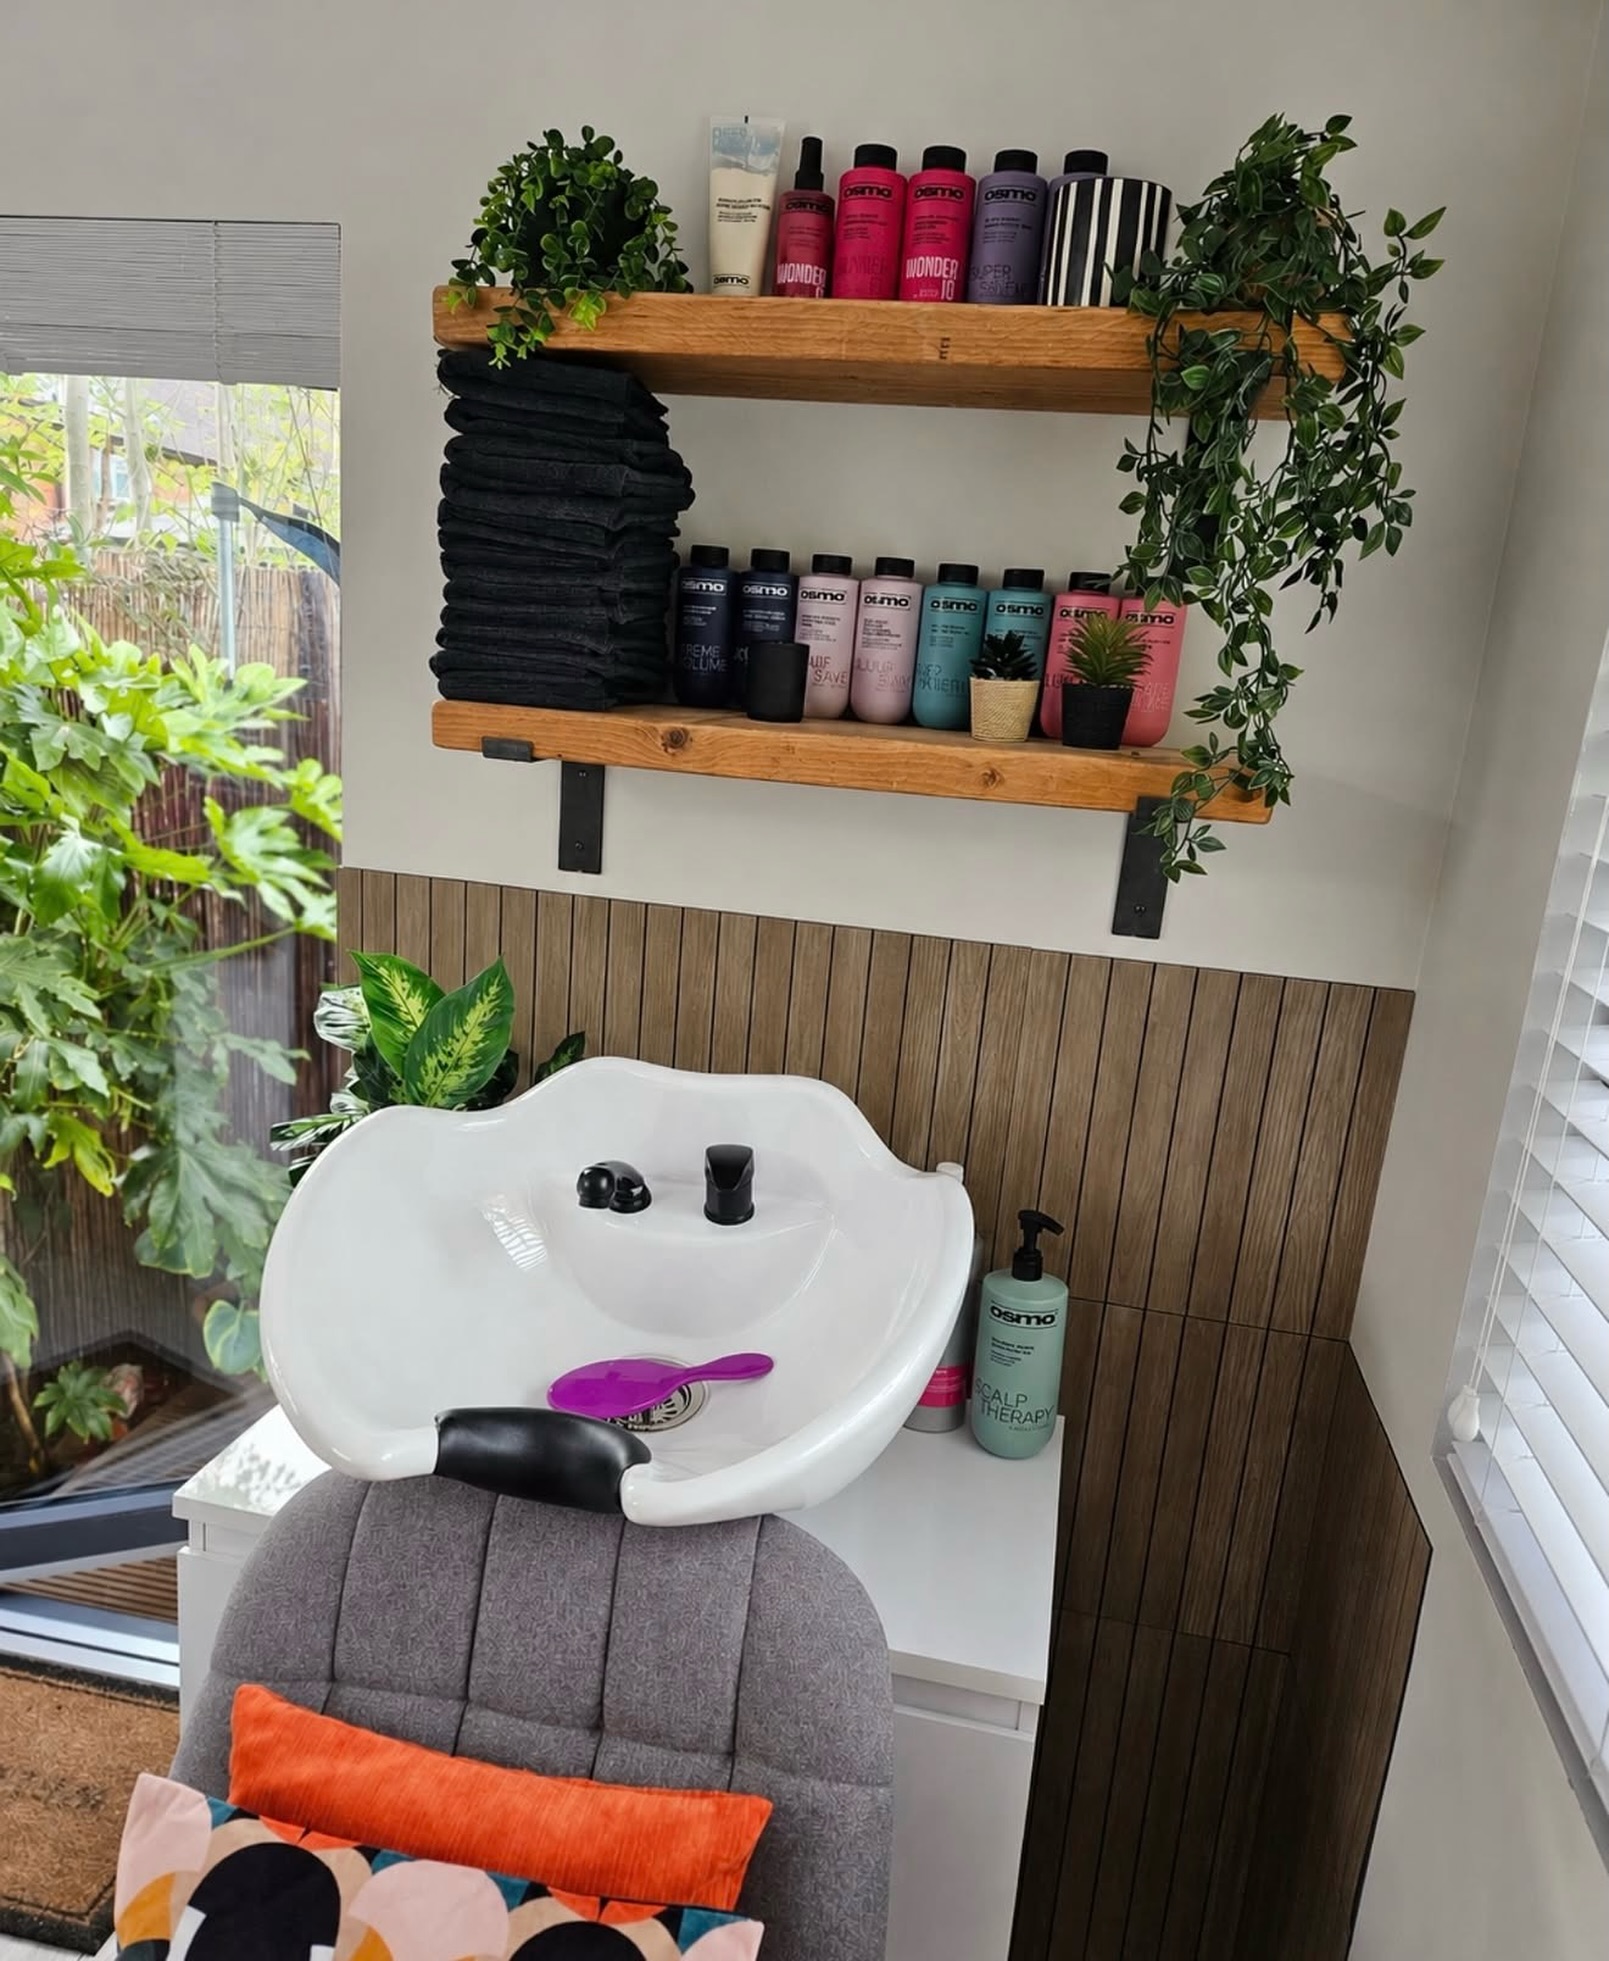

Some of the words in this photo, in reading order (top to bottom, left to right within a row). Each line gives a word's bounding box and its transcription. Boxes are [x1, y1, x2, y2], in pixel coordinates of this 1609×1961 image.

[844, 185, 892, 198] osmo
[914, 186, 964, 199] osmo
[984, 189, 1036, 202] osmo
[906, 256, 958, 280] WONDER
[713, 276, 750, 285] osmo
[777, 263, 827, 287] WONDER
[941, 280, 955, 300] 10
[682, 580, 724, 592] osmo
[743, 585, 788, 597] osmo
[800, 589, 845, 602] osmo
[864, 595, 909, 608] osmo
[930, 599, 978, 612] osmo
[996, 603, 1044, 616] osmo
[1125, 613, 1175, 625] osmo
[813, 669, 848, 685] SAVE
[990, 1305, 1055, 1327] osmo
[974, 1377, 1028, 1407] SCALP
[979, 1400, 1055, 1425] THERAPY
